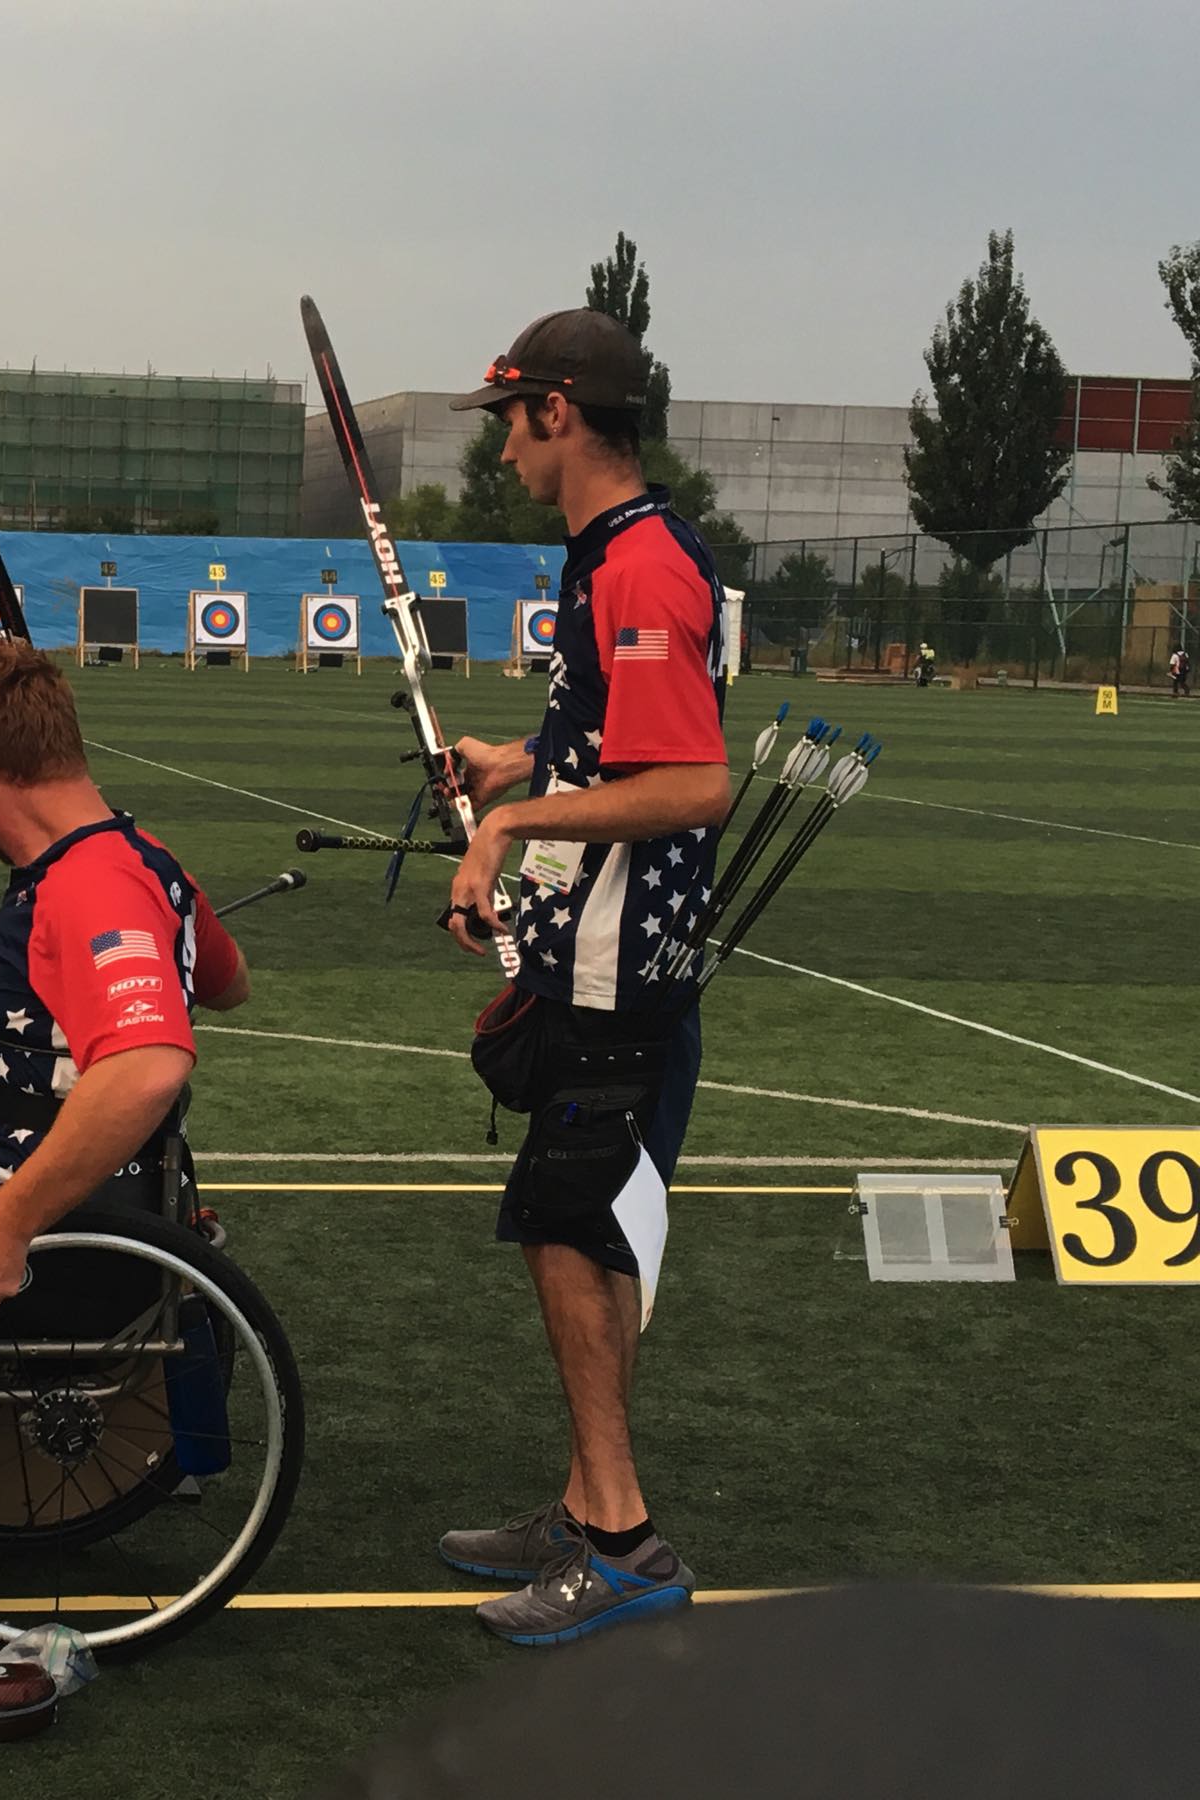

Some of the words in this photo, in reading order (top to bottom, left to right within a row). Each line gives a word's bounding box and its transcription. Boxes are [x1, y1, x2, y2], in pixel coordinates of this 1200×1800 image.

[360, 497, 404, 584] HOYT
[210, 566, 225, 578] 43
[431, 574, 446, 585] 45
[1102, 700, 1112, 709] M
[494, 935, 521, 978] HOY
[110, 978, 160, 996] HOYT
[116, 1014, 164, 1028] EASTON
[1054, 1150, 1200, 1267] 39
